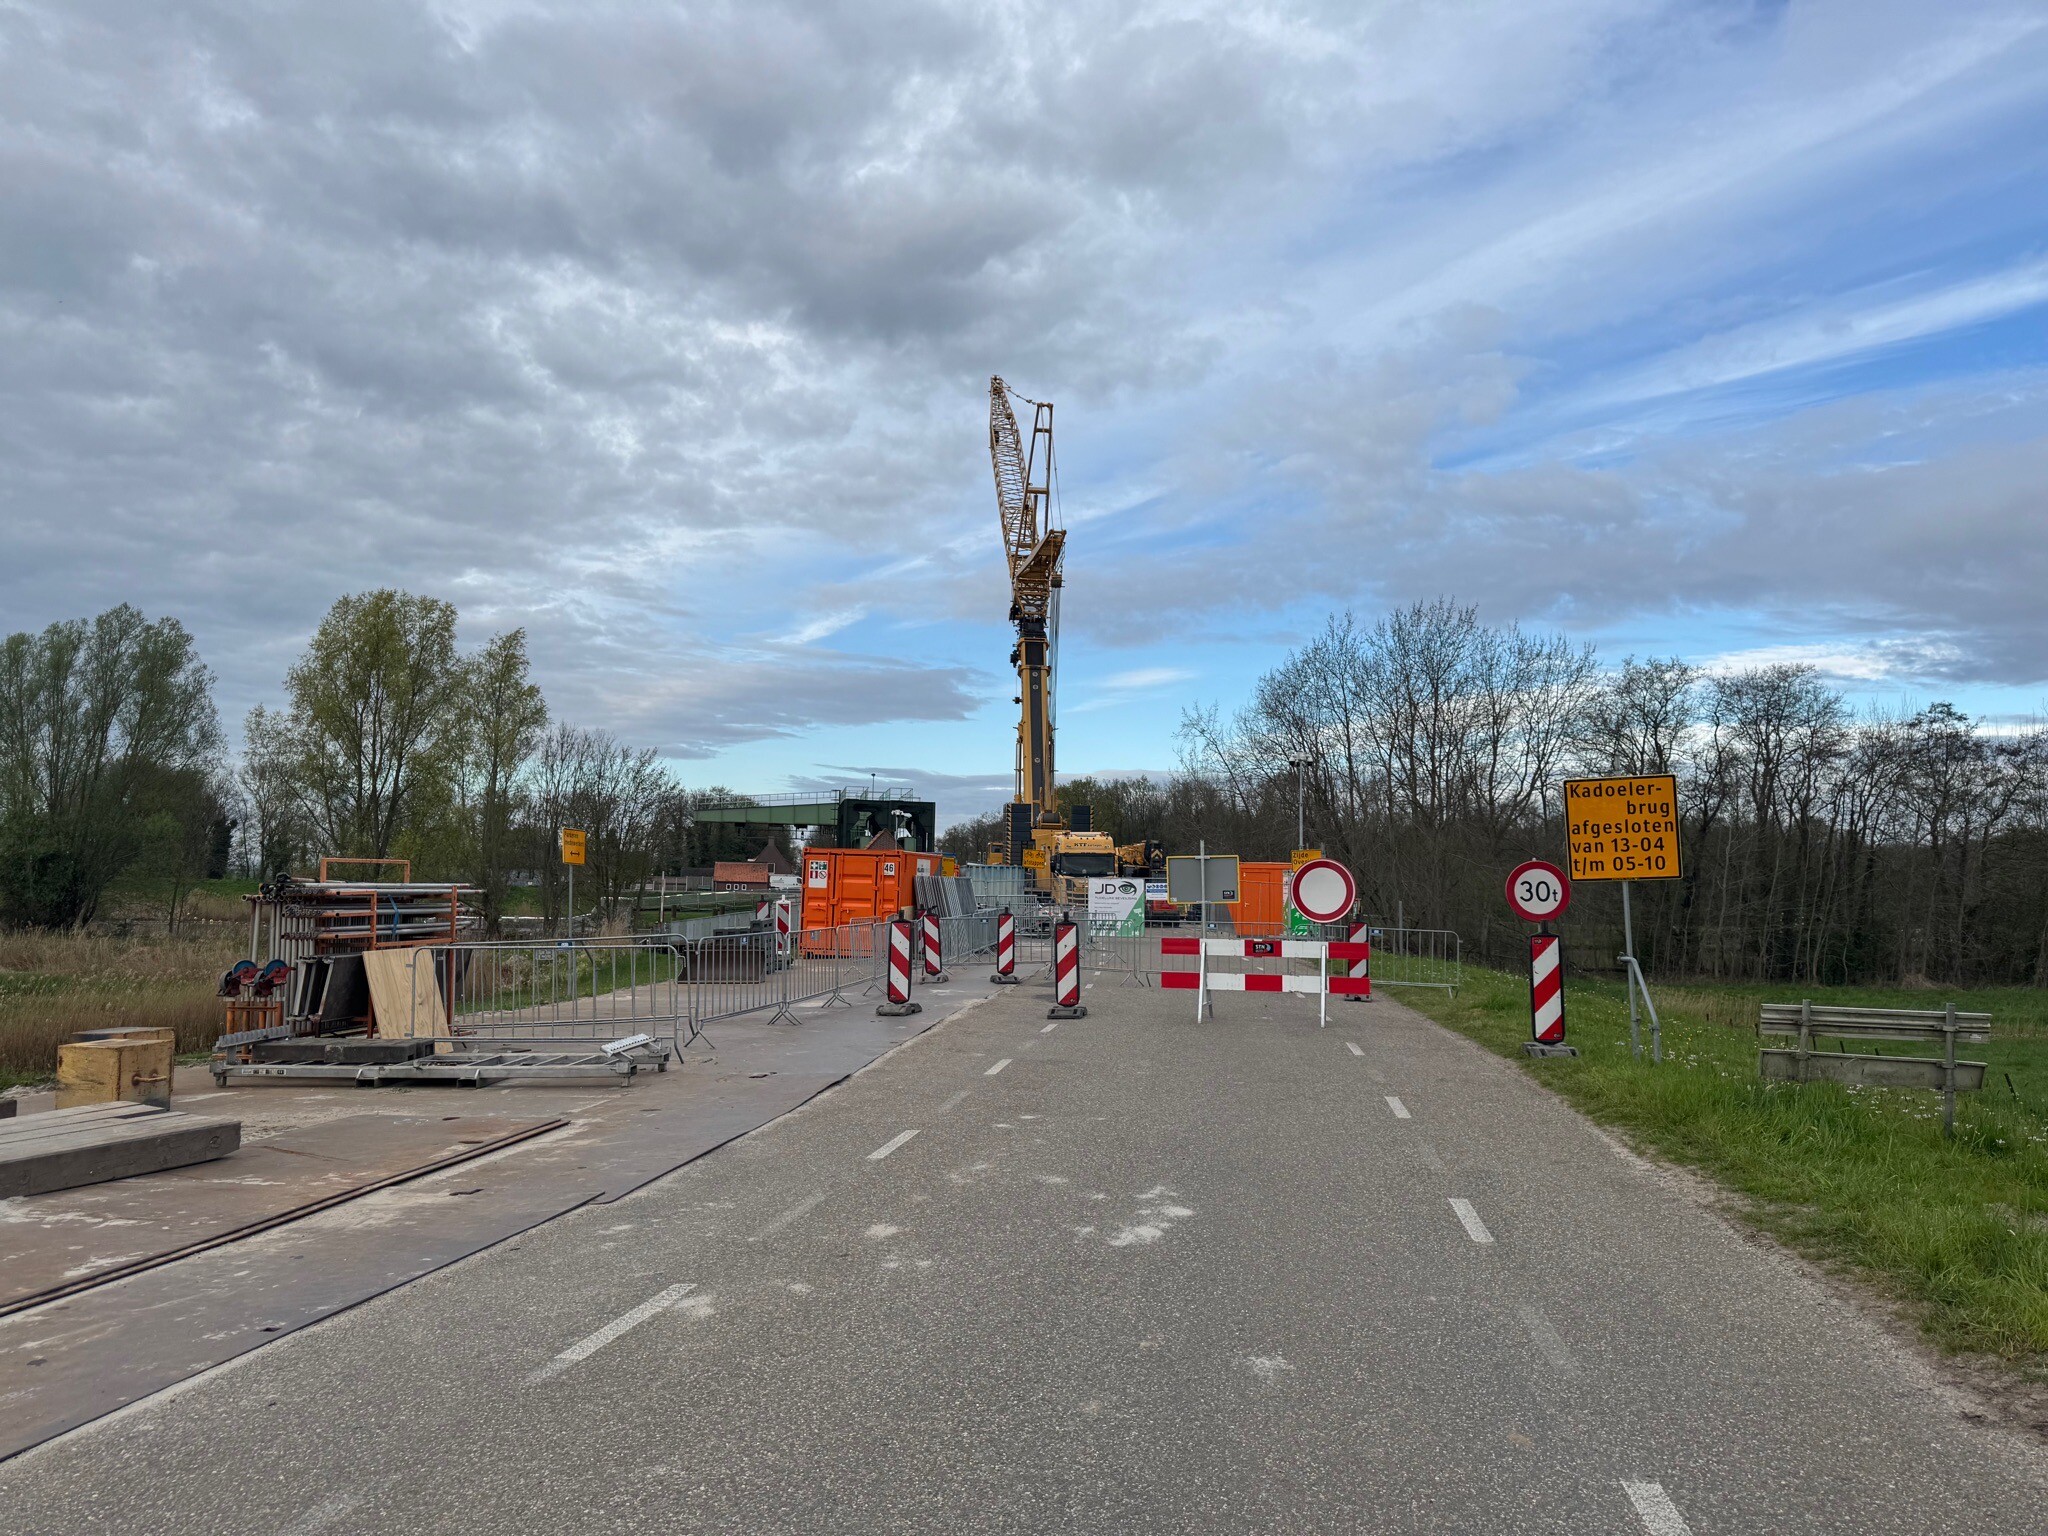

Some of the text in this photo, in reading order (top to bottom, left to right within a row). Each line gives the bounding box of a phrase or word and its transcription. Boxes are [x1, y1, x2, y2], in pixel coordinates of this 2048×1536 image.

[1570, 781, 1662, 798] Kadoeler-
[1627, 800, 1670, 817] brug
[1571, 819, 1674, 838] afgesloten
[1572, 837, 1665, 853] van 13-04
[884, 863, 893, 872] 46
[1573, 855, 1666, 876] t/m 05-10
[1095, 884, 1116, 894] JD
